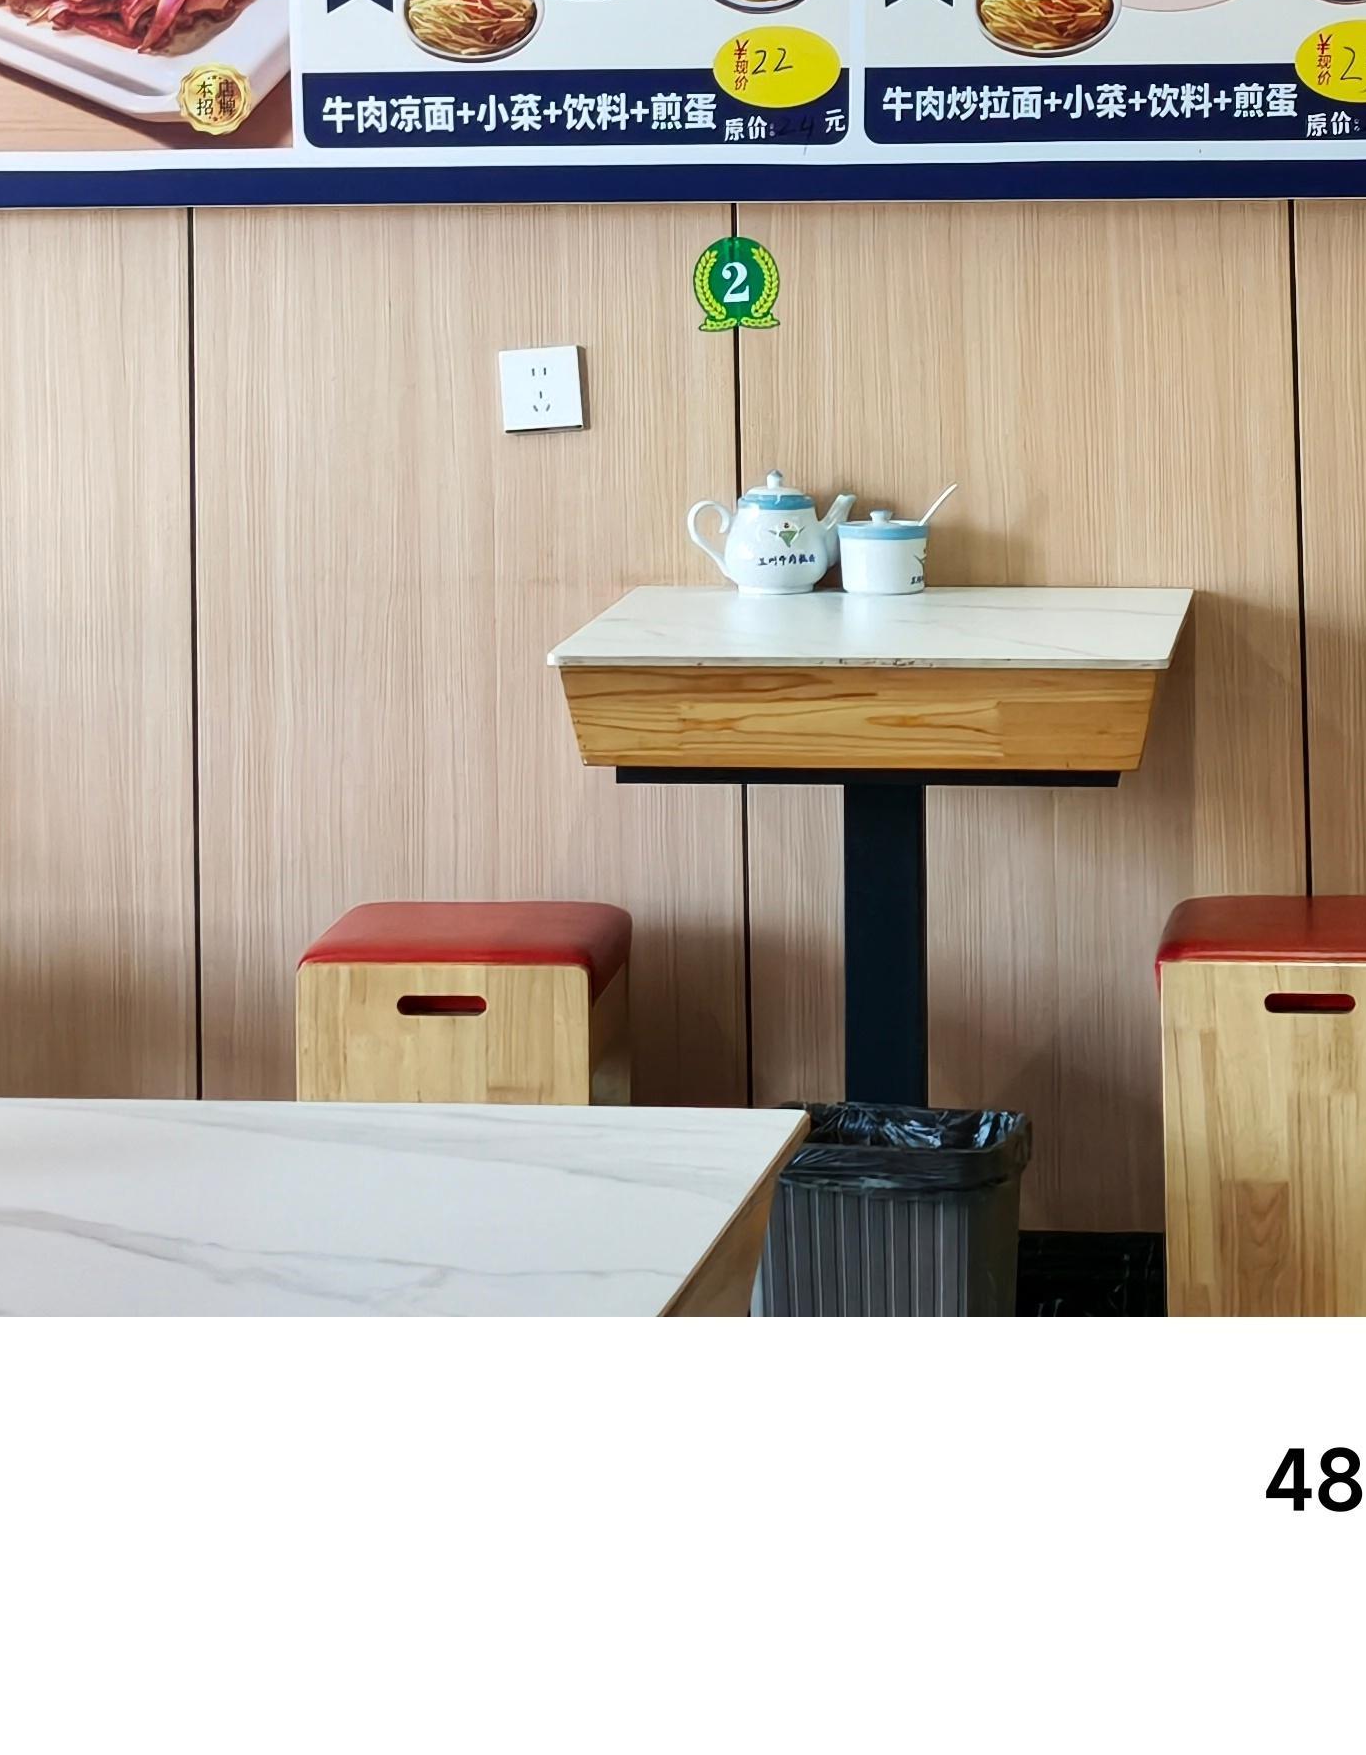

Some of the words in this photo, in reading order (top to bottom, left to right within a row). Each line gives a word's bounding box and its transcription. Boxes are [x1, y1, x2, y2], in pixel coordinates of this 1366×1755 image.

[751, 48, 794, 76] 22
[322, 92, 716, 133] 牛肉凉面+小菜+饮料+煎蛋
[825, 110, 845, 133] 元
[882, 84, 1298, 122] 牛肉炒拉面+小菜+饮料+煎蛋
[722, 262, 750, 302] 2
